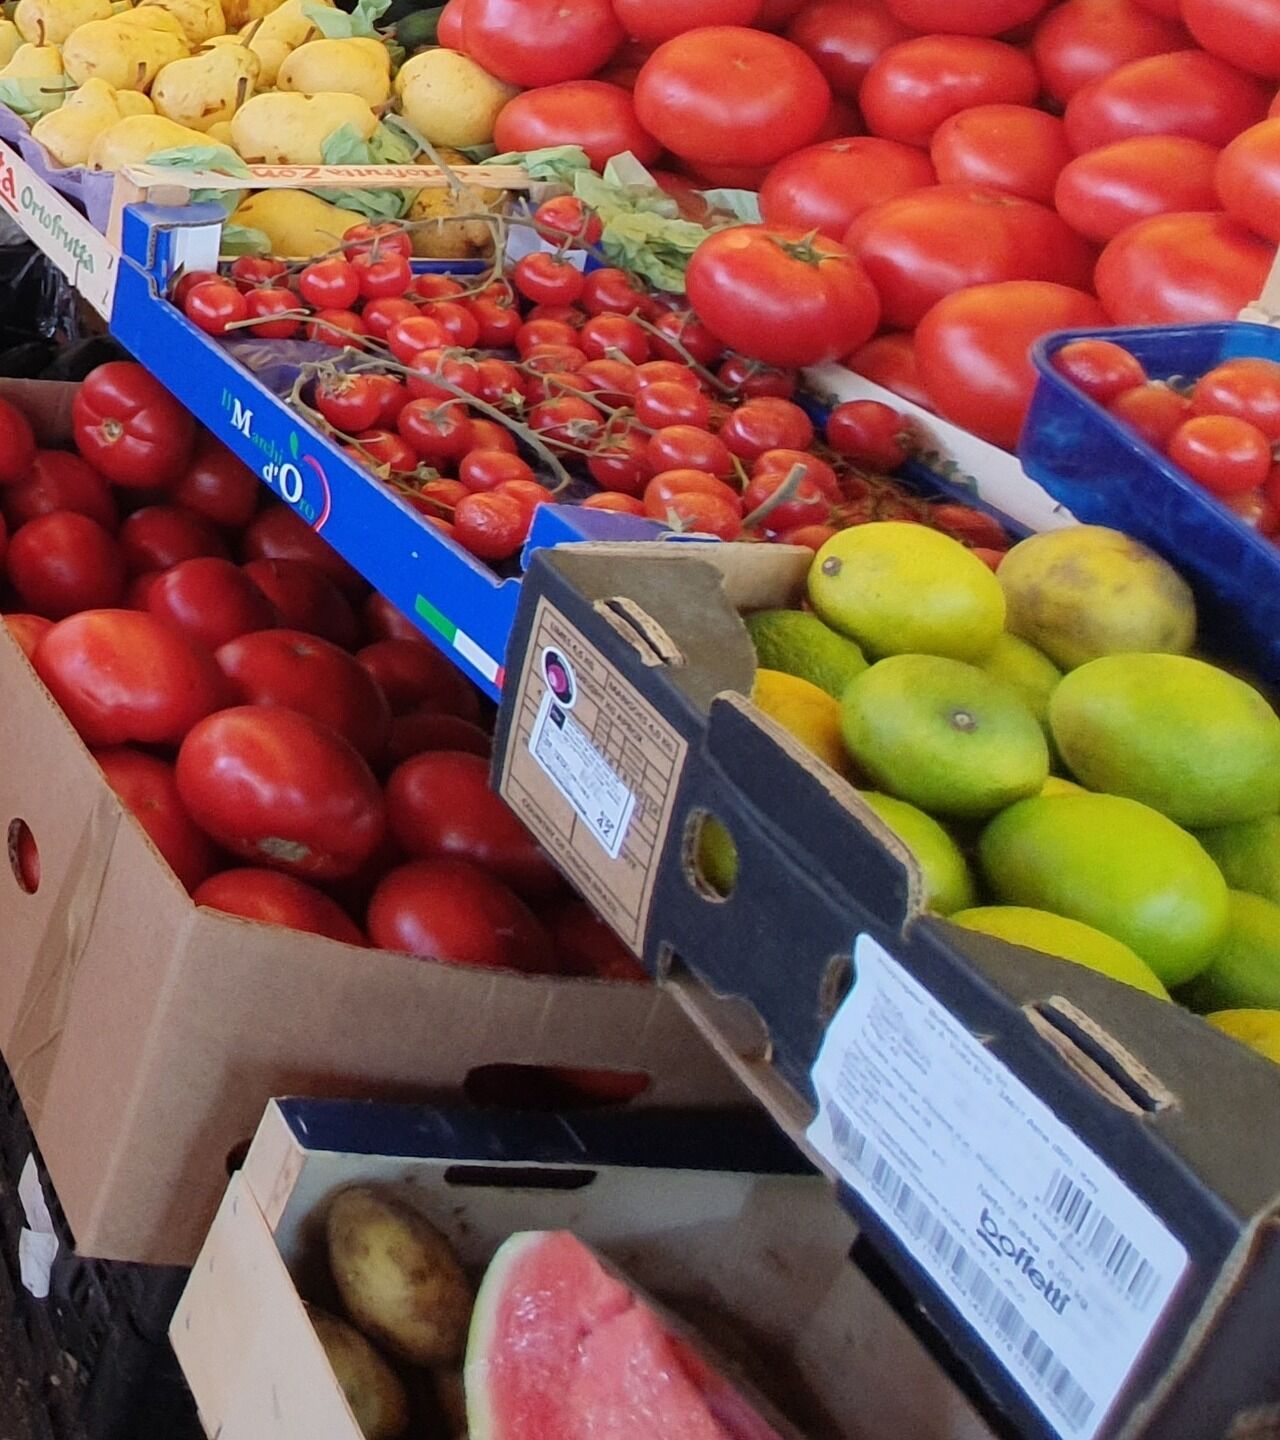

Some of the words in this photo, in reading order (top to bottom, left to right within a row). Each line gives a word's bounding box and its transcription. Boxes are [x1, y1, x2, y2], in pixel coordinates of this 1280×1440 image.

[252, 165, 322, 180] Zon
[19, 185, 95, 275] Ortofrutta
[230, 398, 284, 466] Marchi
[976, 1206, 1072, 1316] boffetti
